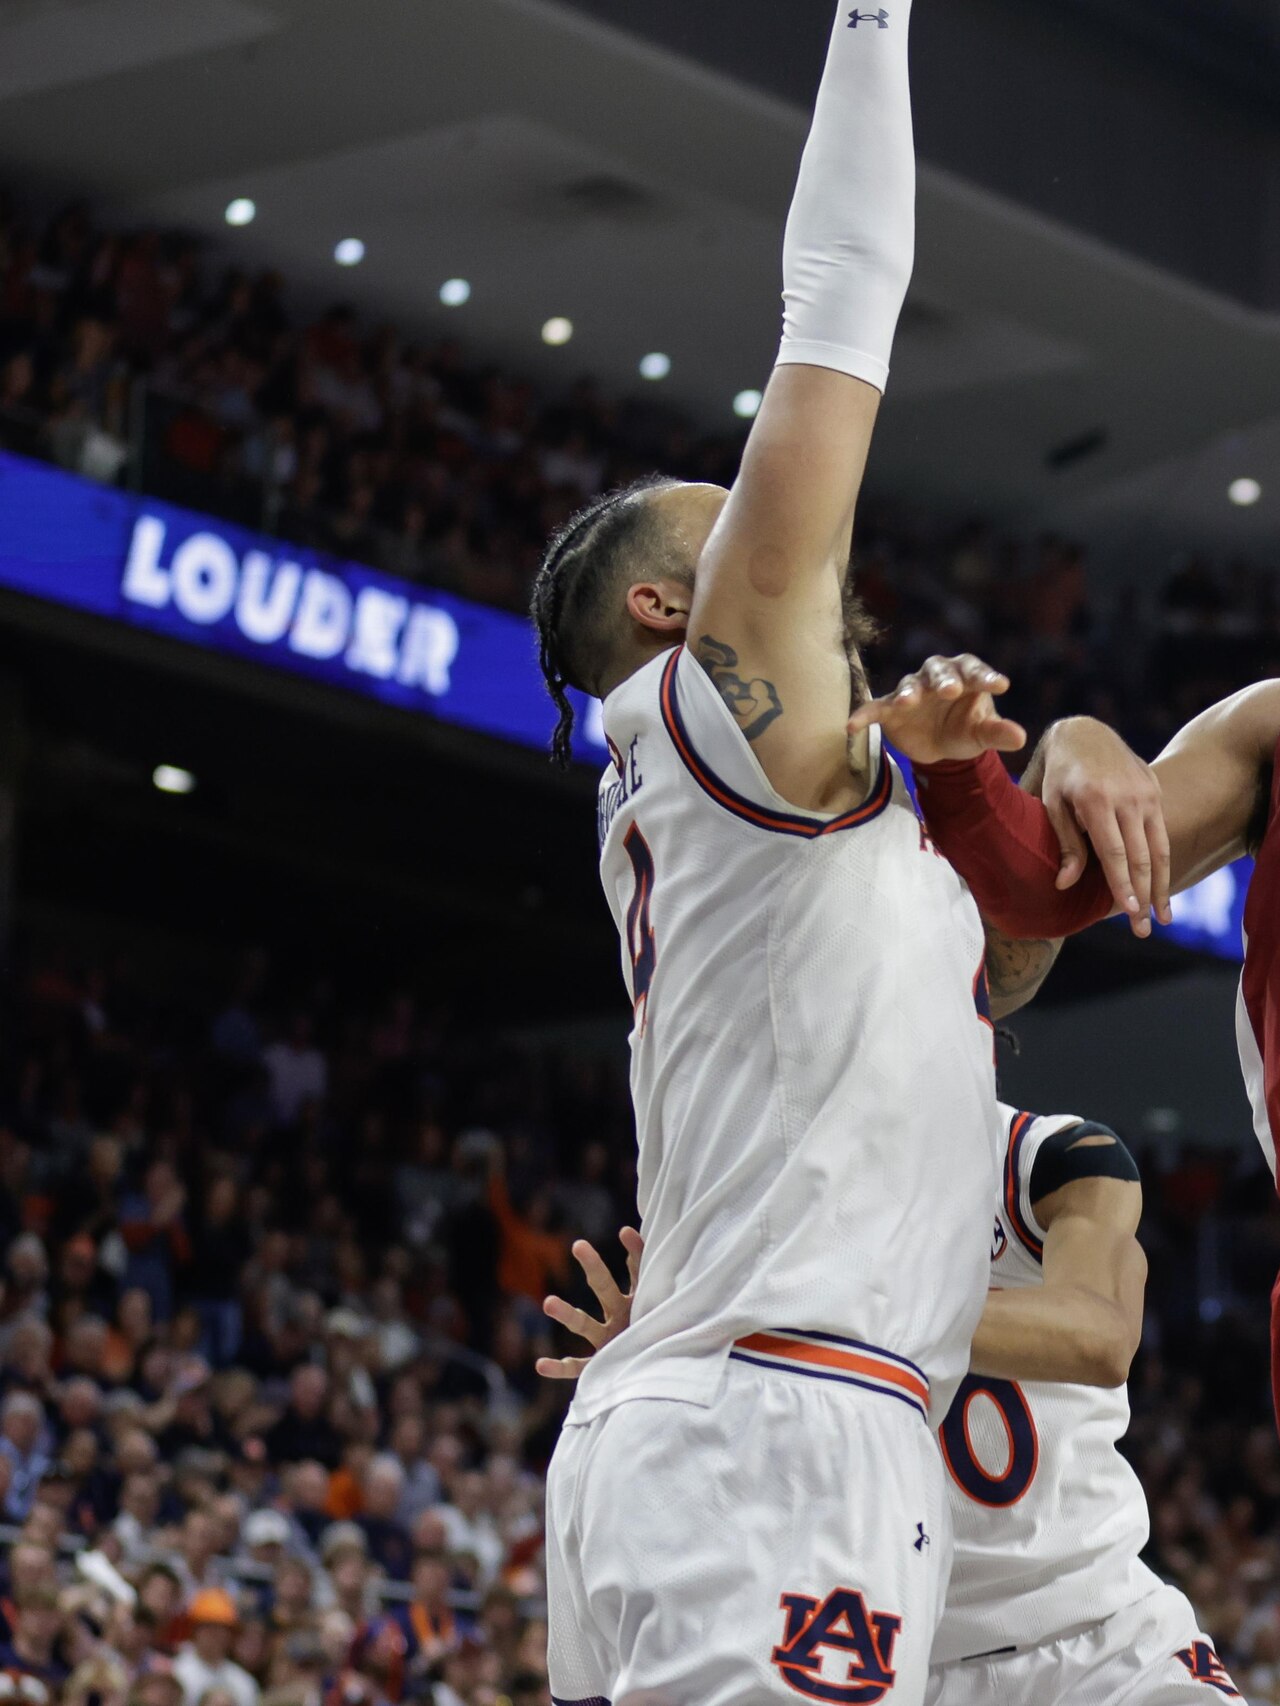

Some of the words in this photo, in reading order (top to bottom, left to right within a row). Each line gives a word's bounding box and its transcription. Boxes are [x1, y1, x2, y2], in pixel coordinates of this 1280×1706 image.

[122, 513, 460, 697] LOUDER
[938, 1372, 1039, 1508] 0
[769, 1586, 903, 1706] AU
